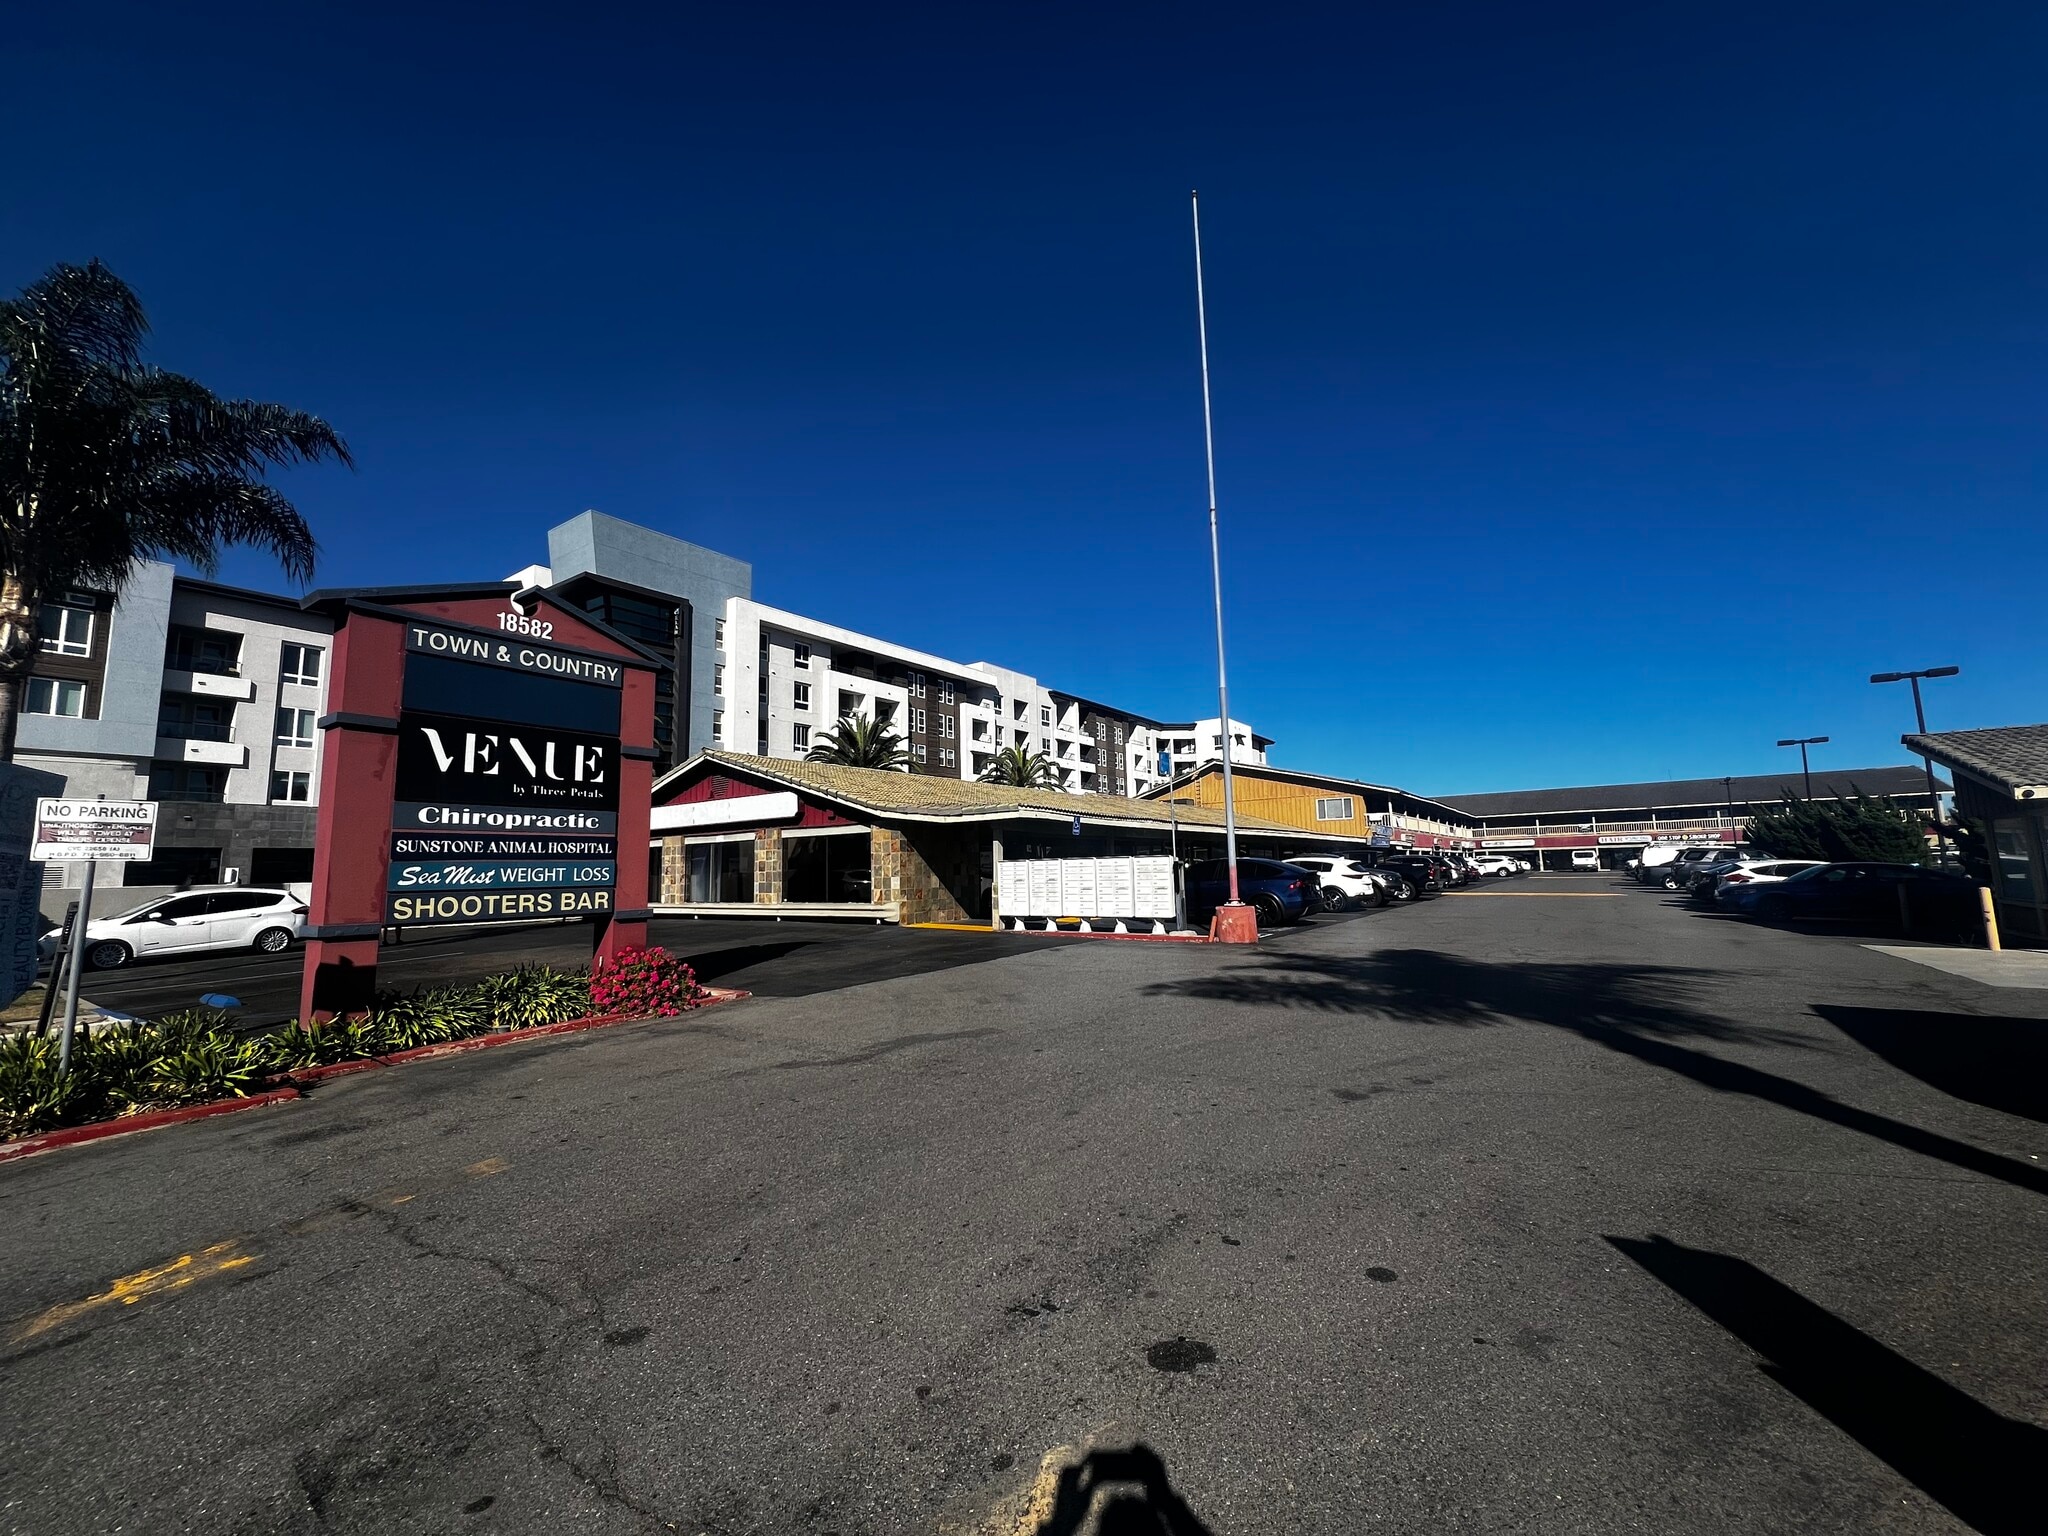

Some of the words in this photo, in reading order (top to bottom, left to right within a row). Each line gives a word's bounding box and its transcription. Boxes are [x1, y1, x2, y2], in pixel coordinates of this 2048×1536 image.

[497, 611, 553, 641] 18582
[412, 628, 488, 659] TOWN
[496, 645, 511, 663] &
[519, 650, 619, 682] COUNTRY
[420, 727, 604, 783] VENUE
[513, 784, 525, 796] by
[531, 785, 566, 796] Three
[571, 788, 604, 798] Petals
[47, 805, 71, 816] NO
[79, 806, 148, 819] PARKING
[418, 806, 600, 830] Chiropractic
[396, 839, 484, 853] SUNSTONE
[487, 841, 545, 854] ANIMAL
[548, 842, 612, 854] HOSPITAL
[397, 866, 441, 886] Sea
[443, 865, 495, 885] Mist
[500, 868, 566, 882] WEIGHT
[573, 867, 610, 881] LOSS
[394, 893, 552, 919] SHOOTERS
[560, 891, 609, 911] BAR
